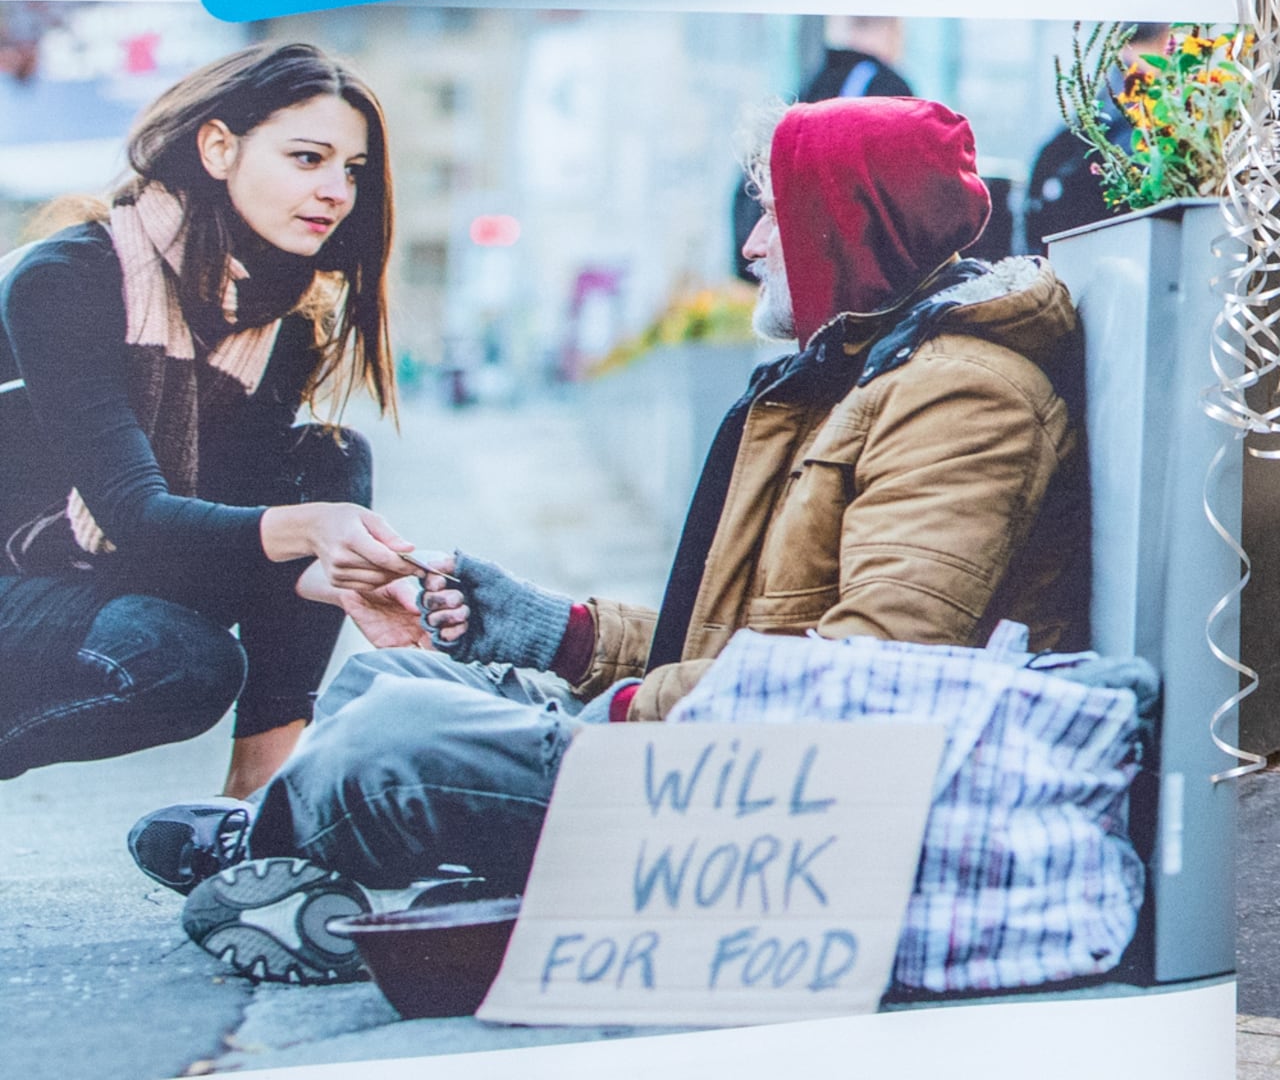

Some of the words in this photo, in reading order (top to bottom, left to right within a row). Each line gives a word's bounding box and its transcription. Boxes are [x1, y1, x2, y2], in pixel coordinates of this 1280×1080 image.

[634, 834, 837, 913] WORK
[540, 931, 660, 993] FOR
[709, 927, 859, 993] FOOD
